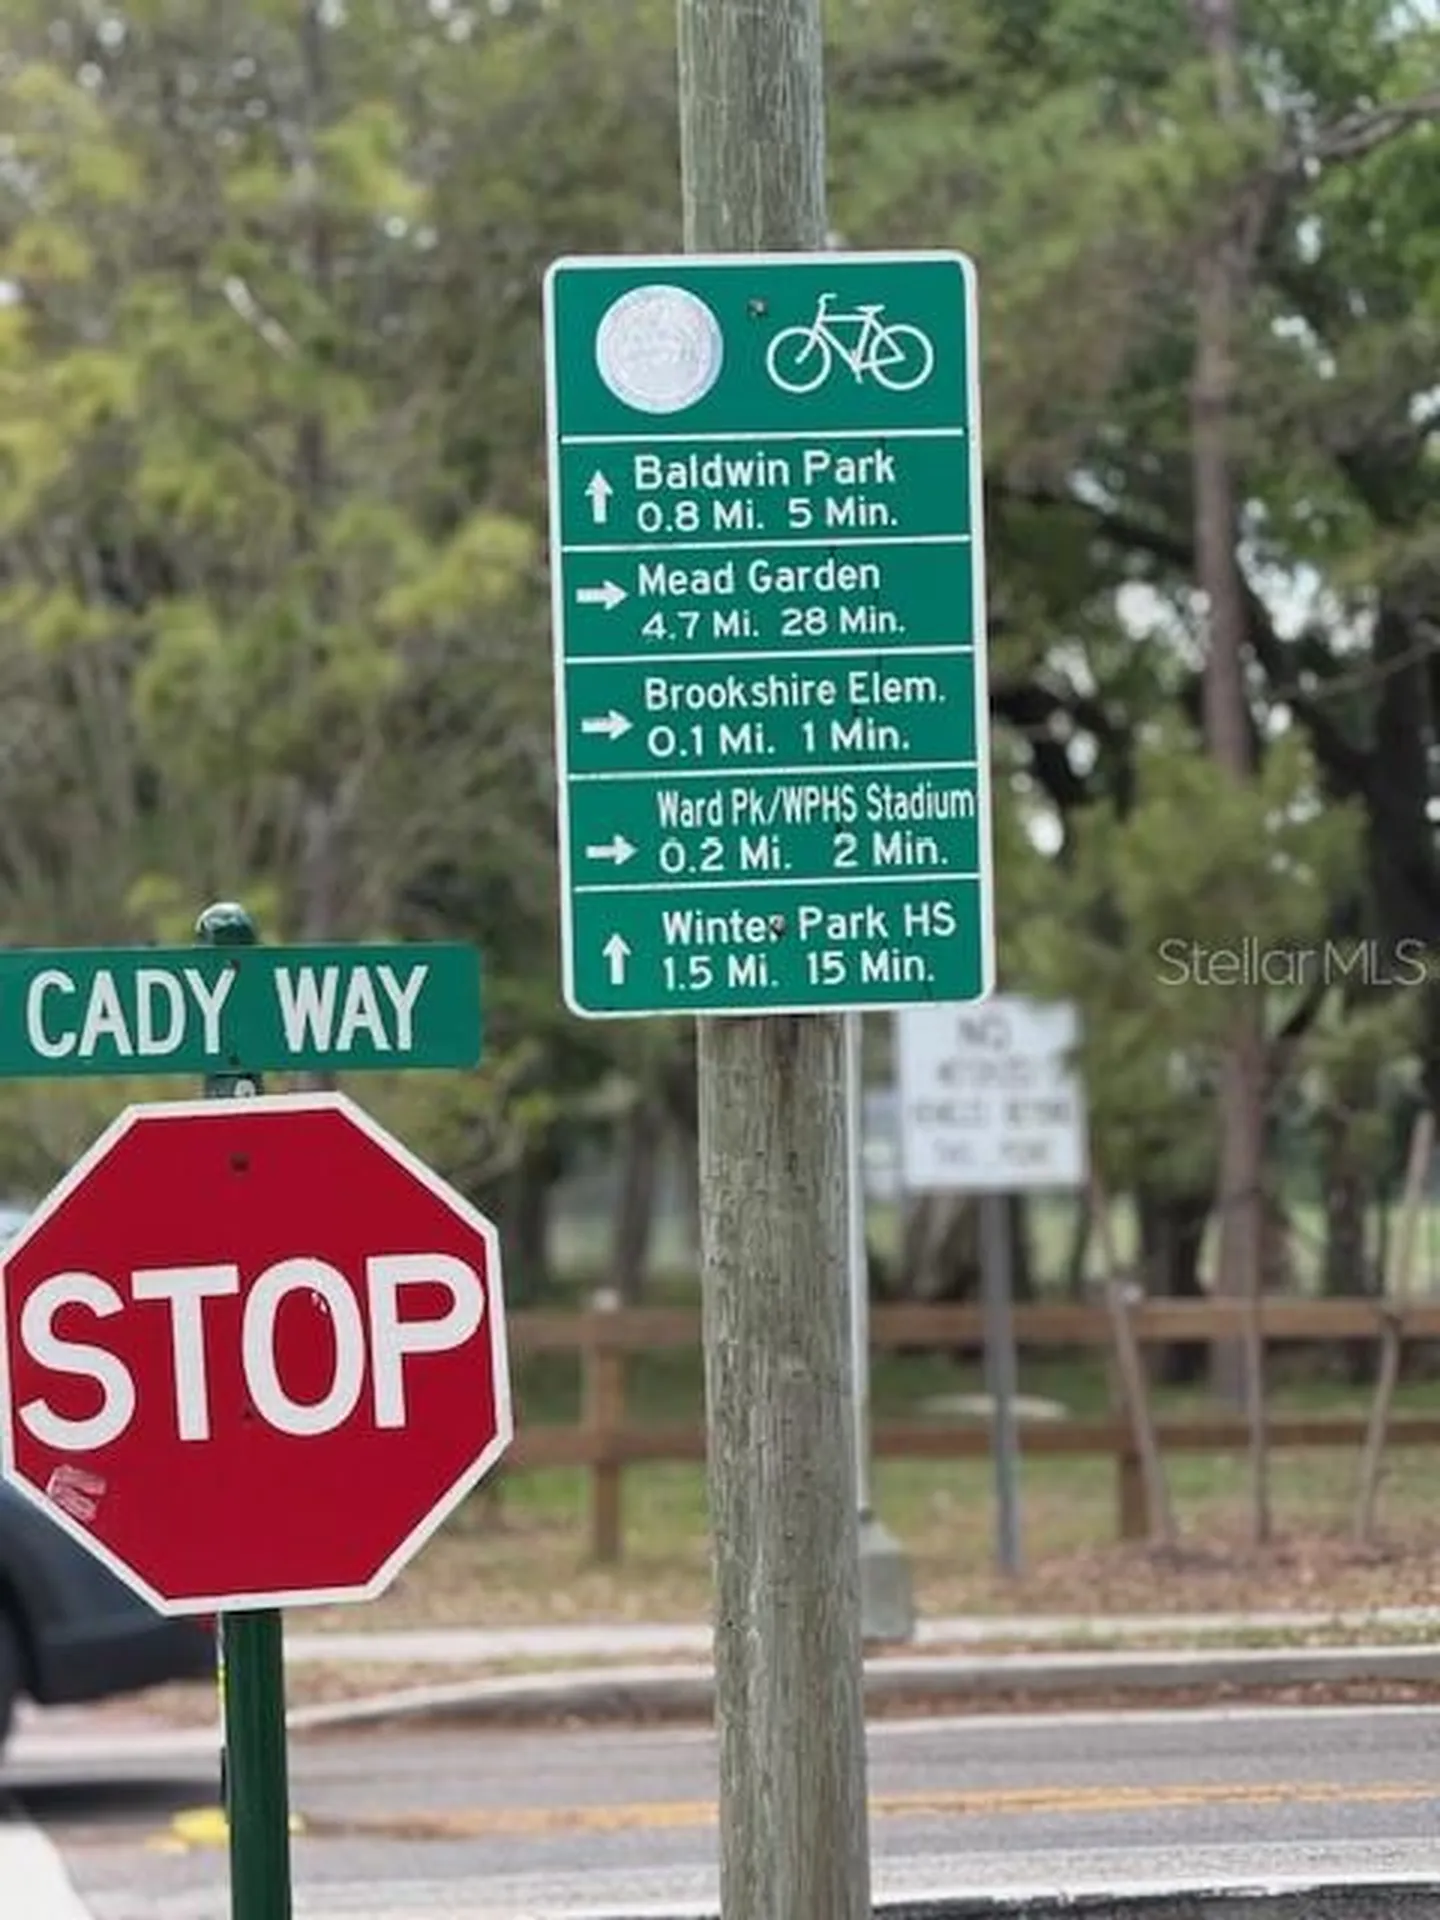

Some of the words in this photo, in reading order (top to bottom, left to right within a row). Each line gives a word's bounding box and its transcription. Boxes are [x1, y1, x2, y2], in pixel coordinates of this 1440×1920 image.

[634, 452, 789, 491] Baldwin
[804, 448, 896, 485] Park
[637, 501, 699, 532] 0.8
[713, 500, 764, 530] Mi.
[788, 497, 813, 529] 5
[826, 496, 899, 527] Min.
[637, 561, 735, 596] Mead
[748, 558, 880, 593] Garden
[641, 612, 700, 642] 4.7
[713, 610, 760, 639] Mi.
[781, 609, 828, 637] 28
[839, 606, 906, 634] Min.
[644, 673, 837, 711] Brookshire
[849, 671, 946, 705] Elem.
[647, 725, 703, 757] 0.1
[719, 723, 775, 755] Mi.
[803, 722, 815, 751] 1
[831, 718, 911, 751] Min.
[657, 788, 724, 828] Ward
[731, 784, 857, 826] Pk/WPHS
[866, 781, 975, 821] Stadium
[659, 838, 724, 873] 0.2
[740, 836, 792, 870] Mi.
[833, 832, 859, 868] 2
[872, 831, 949, 866] Min.
[799, 904, 889, 940] Park
[903, 902, 957, 937] HS
[662, 956, 712, 991] 1.5
[728, 954, 779, 987] Mi.
[807, 951, 847, 985] 15
[860, 949, 936, 983] Min.
[26, 968, 236, 1058] CADY
[274, 964, 428, 1053] WAY
[19, 1253, 485, 1451] STOP
